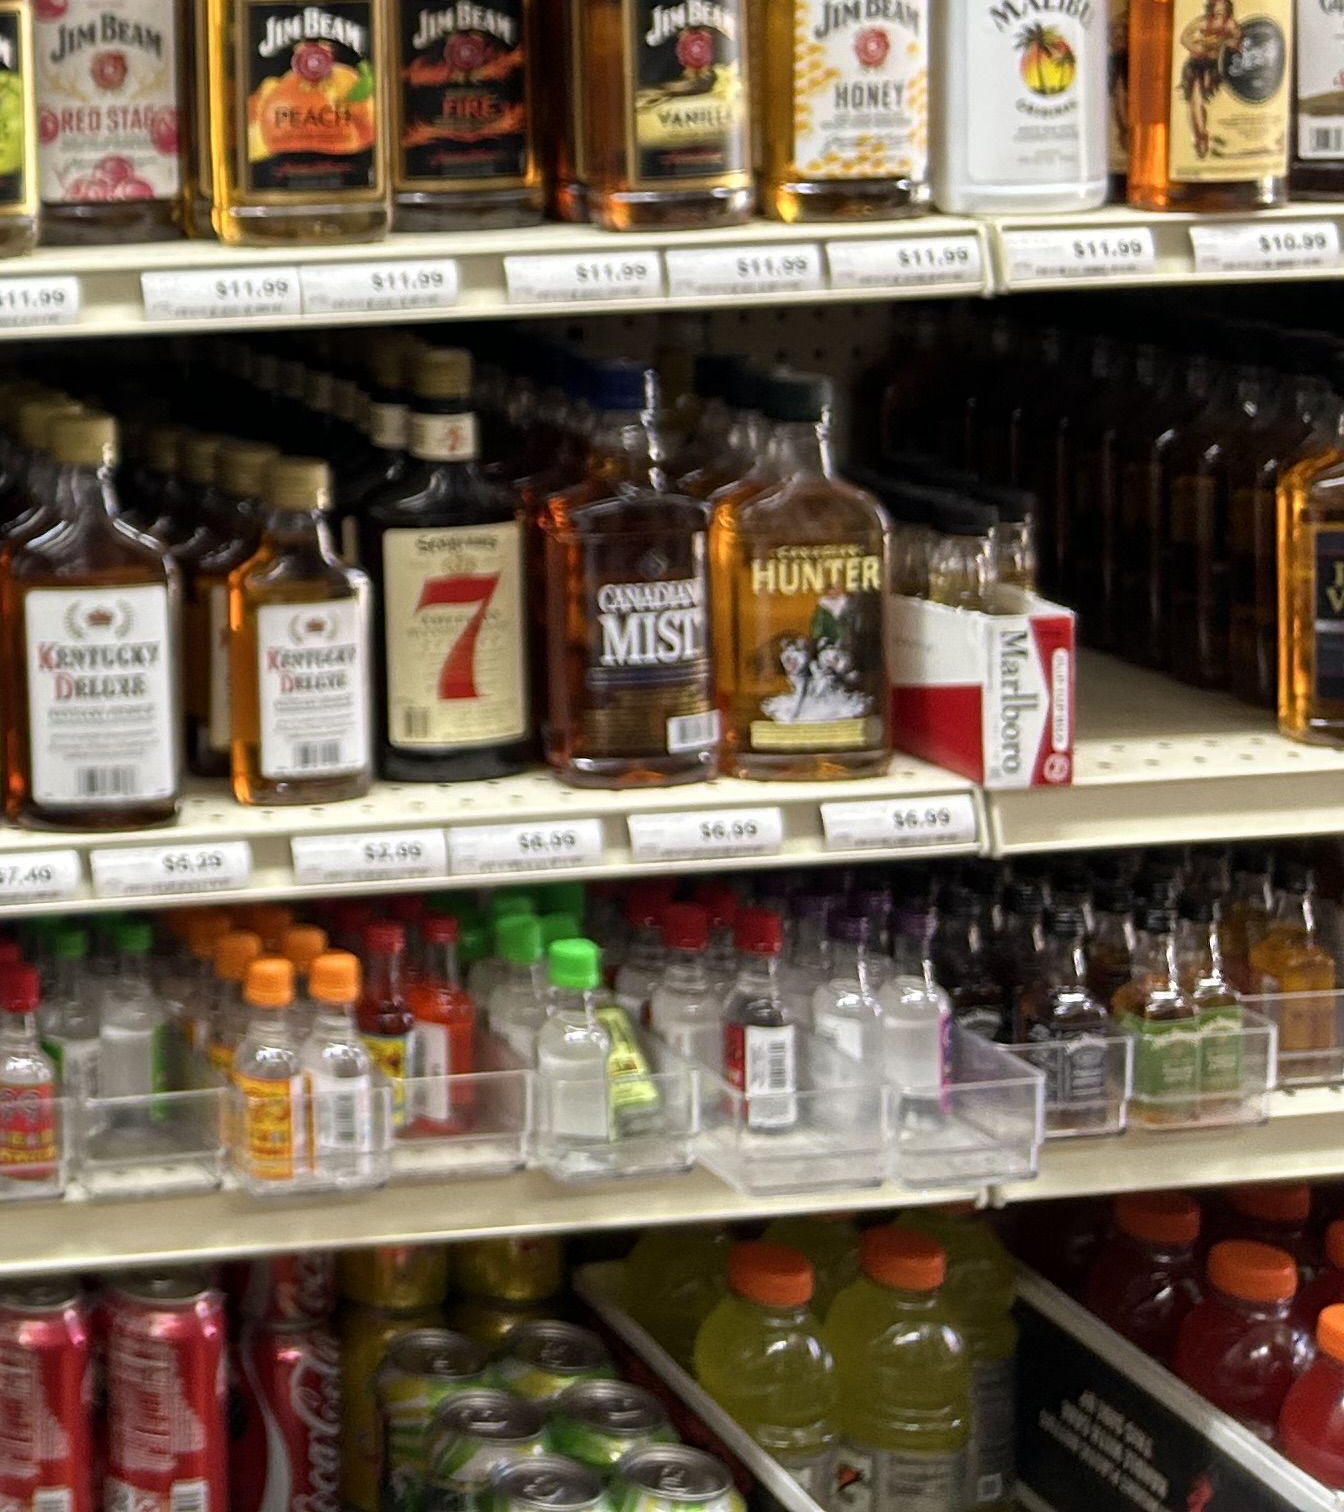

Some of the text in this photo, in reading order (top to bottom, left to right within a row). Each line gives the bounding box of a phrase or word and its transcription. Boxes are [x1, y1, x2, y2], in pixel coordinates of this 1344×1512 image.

[49, 12, 163, 63] JIM BEAM
[258, 6, 362, 57] JIM BEAM
[412, 0, 512, 50] JIM BEAM
[645, 3, 686, 45] JIM
[441, 93, 496, 118] FIRE
[834, 81, 905, 109] HONEY
[60, 104, 154, 132] RED STAG
[273, 105, 353, 128] PEACH
[751, 557, 880, 594] HUNTER
[598, 582, 702, 613] CANADIAN
[415, 570, 501, 700] 7
[598, 613, 701, 666] MIST
[37, 640, 161, 671] KENTUCKY
[266, 643, 356, 665] KENTUCKY
[54, 671, 146, 701] DELUXE
[1000, 630, 1039, 774] Marlboro
